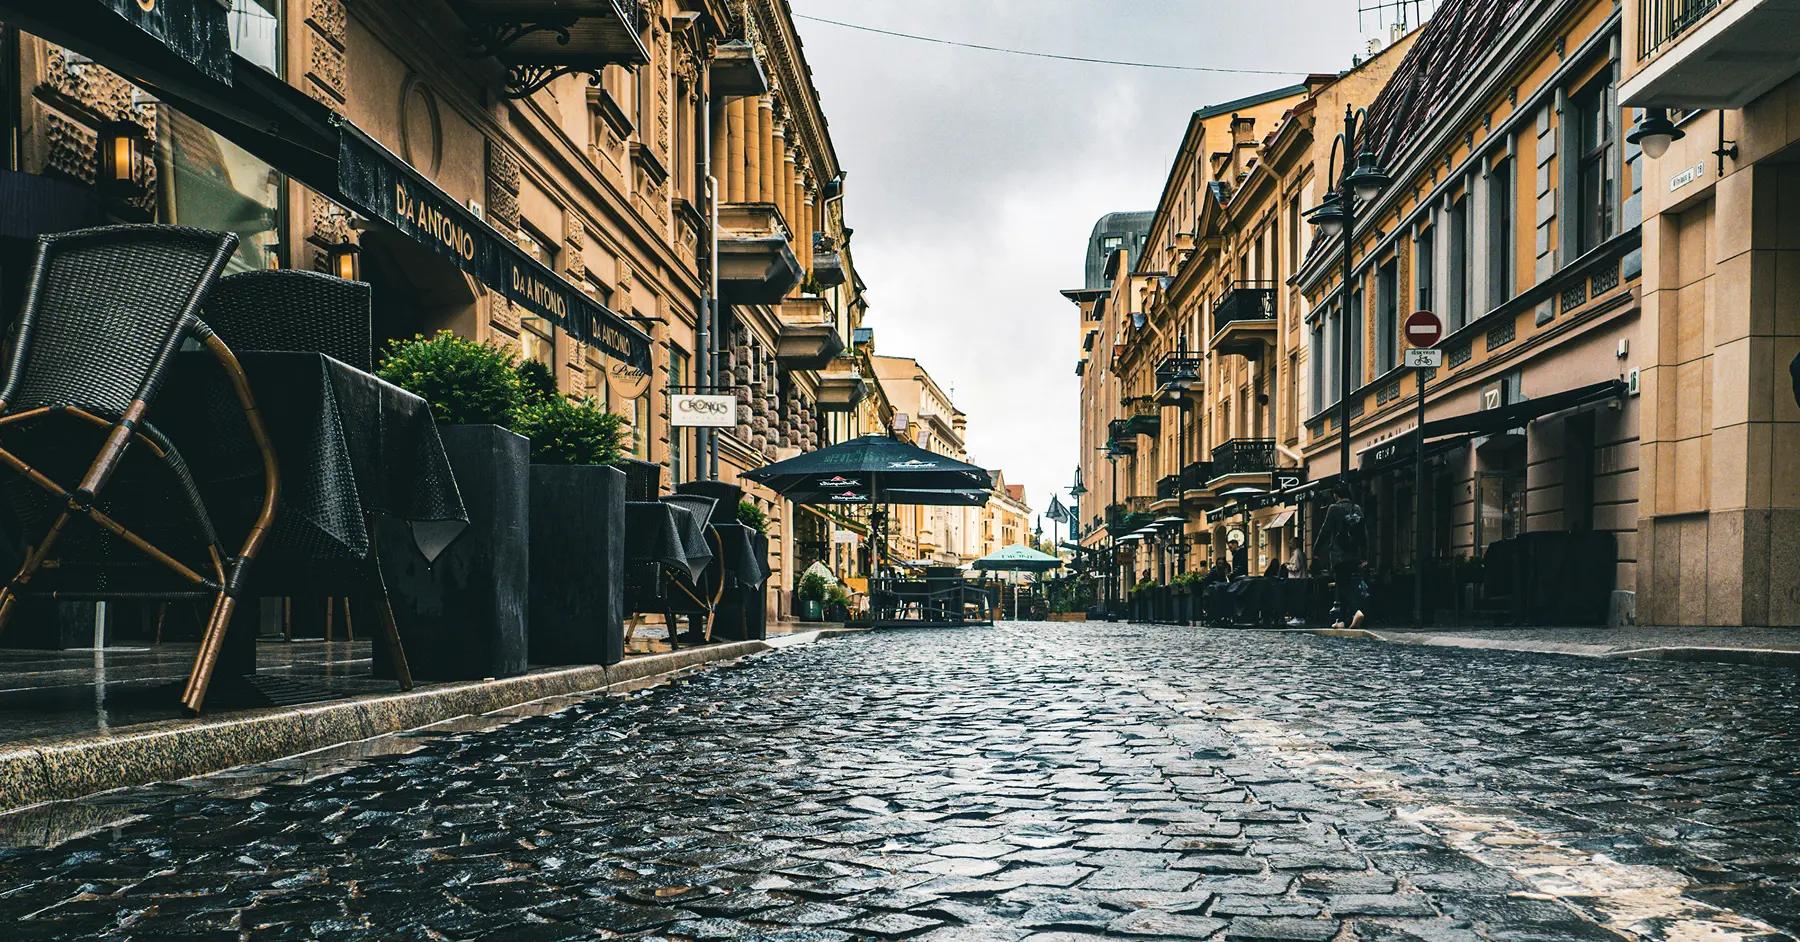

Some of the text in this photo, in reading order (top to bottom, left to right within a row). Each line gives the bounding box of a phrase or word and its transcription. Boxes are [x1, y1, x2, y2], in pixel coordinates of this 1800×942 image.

[396, 184, 474, 260] DA ANTONIO
[513, 265, 566, 319] DA ANTONIO
[593, 316, 631, 357] DA ANTONIO
[1630, 371, 1637, 391] 16
